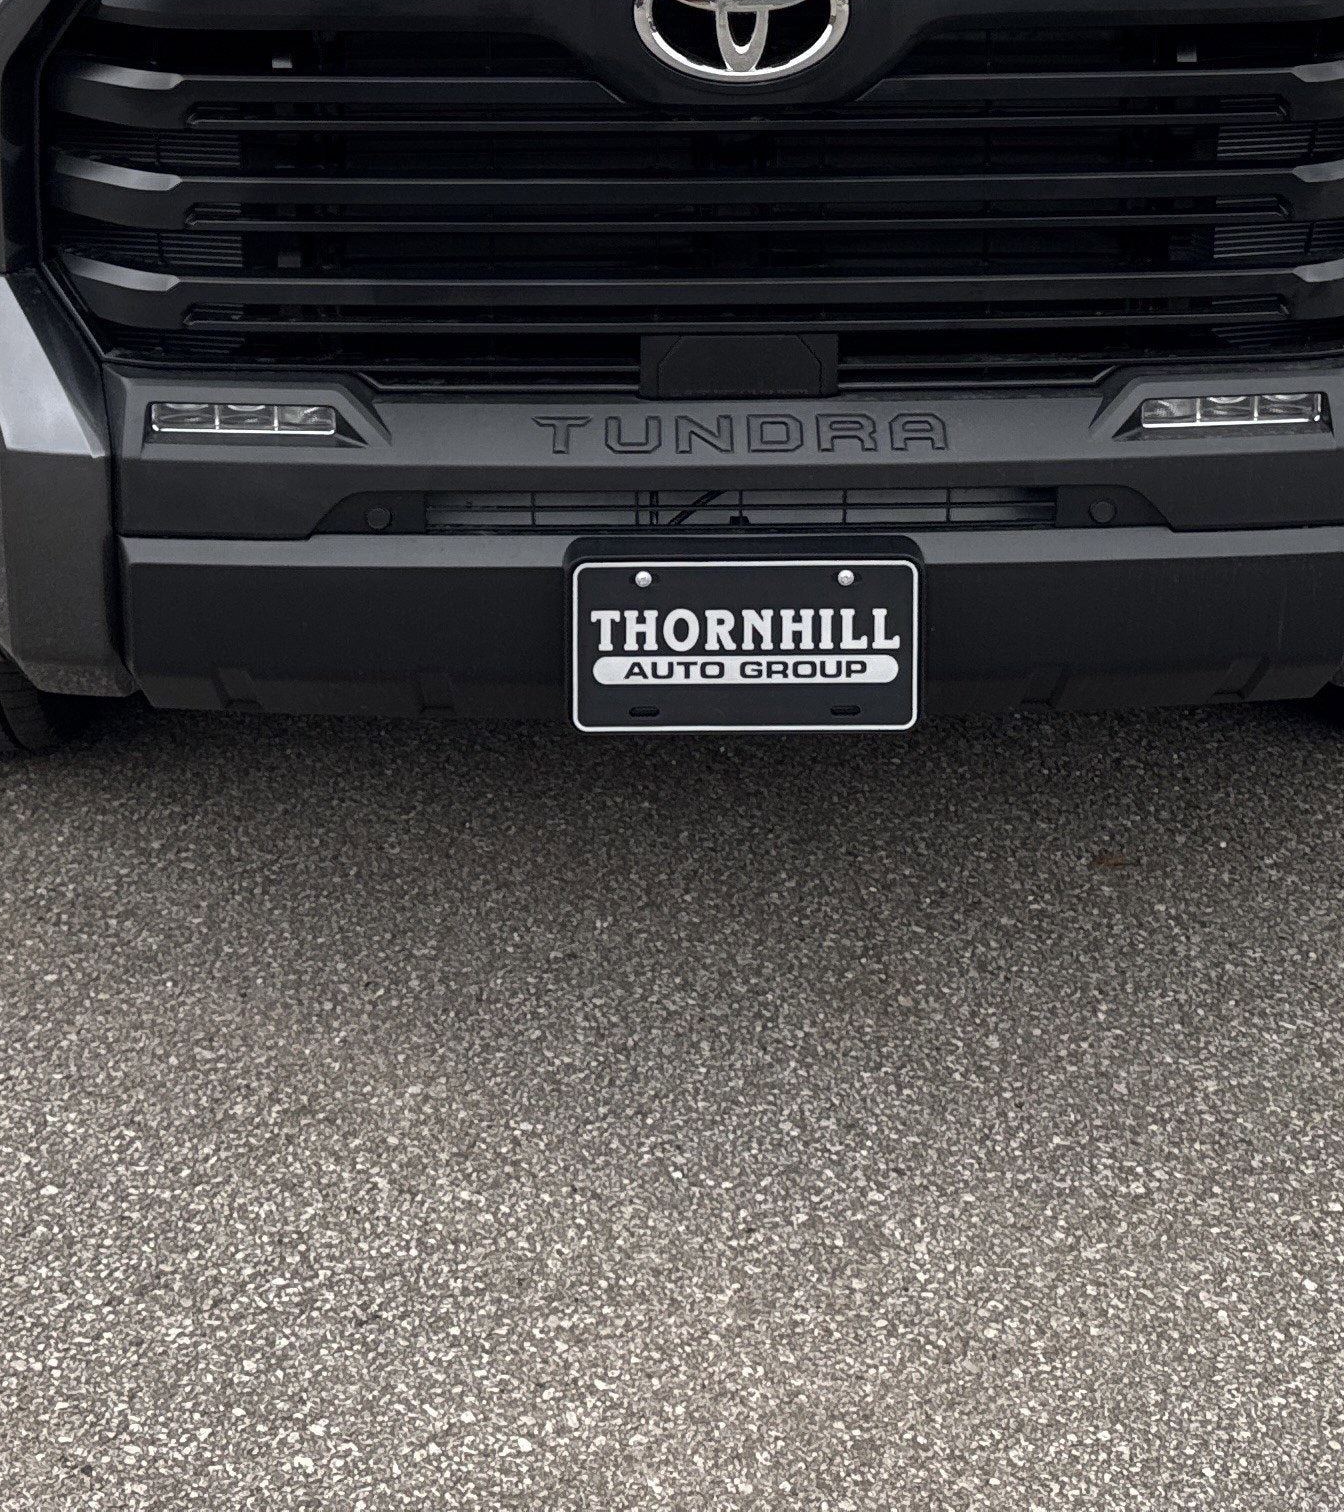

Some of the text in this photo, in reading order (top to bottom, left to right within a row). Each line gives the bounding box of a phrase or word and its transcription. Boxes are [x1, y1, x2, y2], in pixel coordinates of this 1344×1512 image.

[532, 413, 949, 454] TUNDRA
[591, 608, 900, 651] THORNHILL
[624, 659, 868, 680] AUTO GROUP
